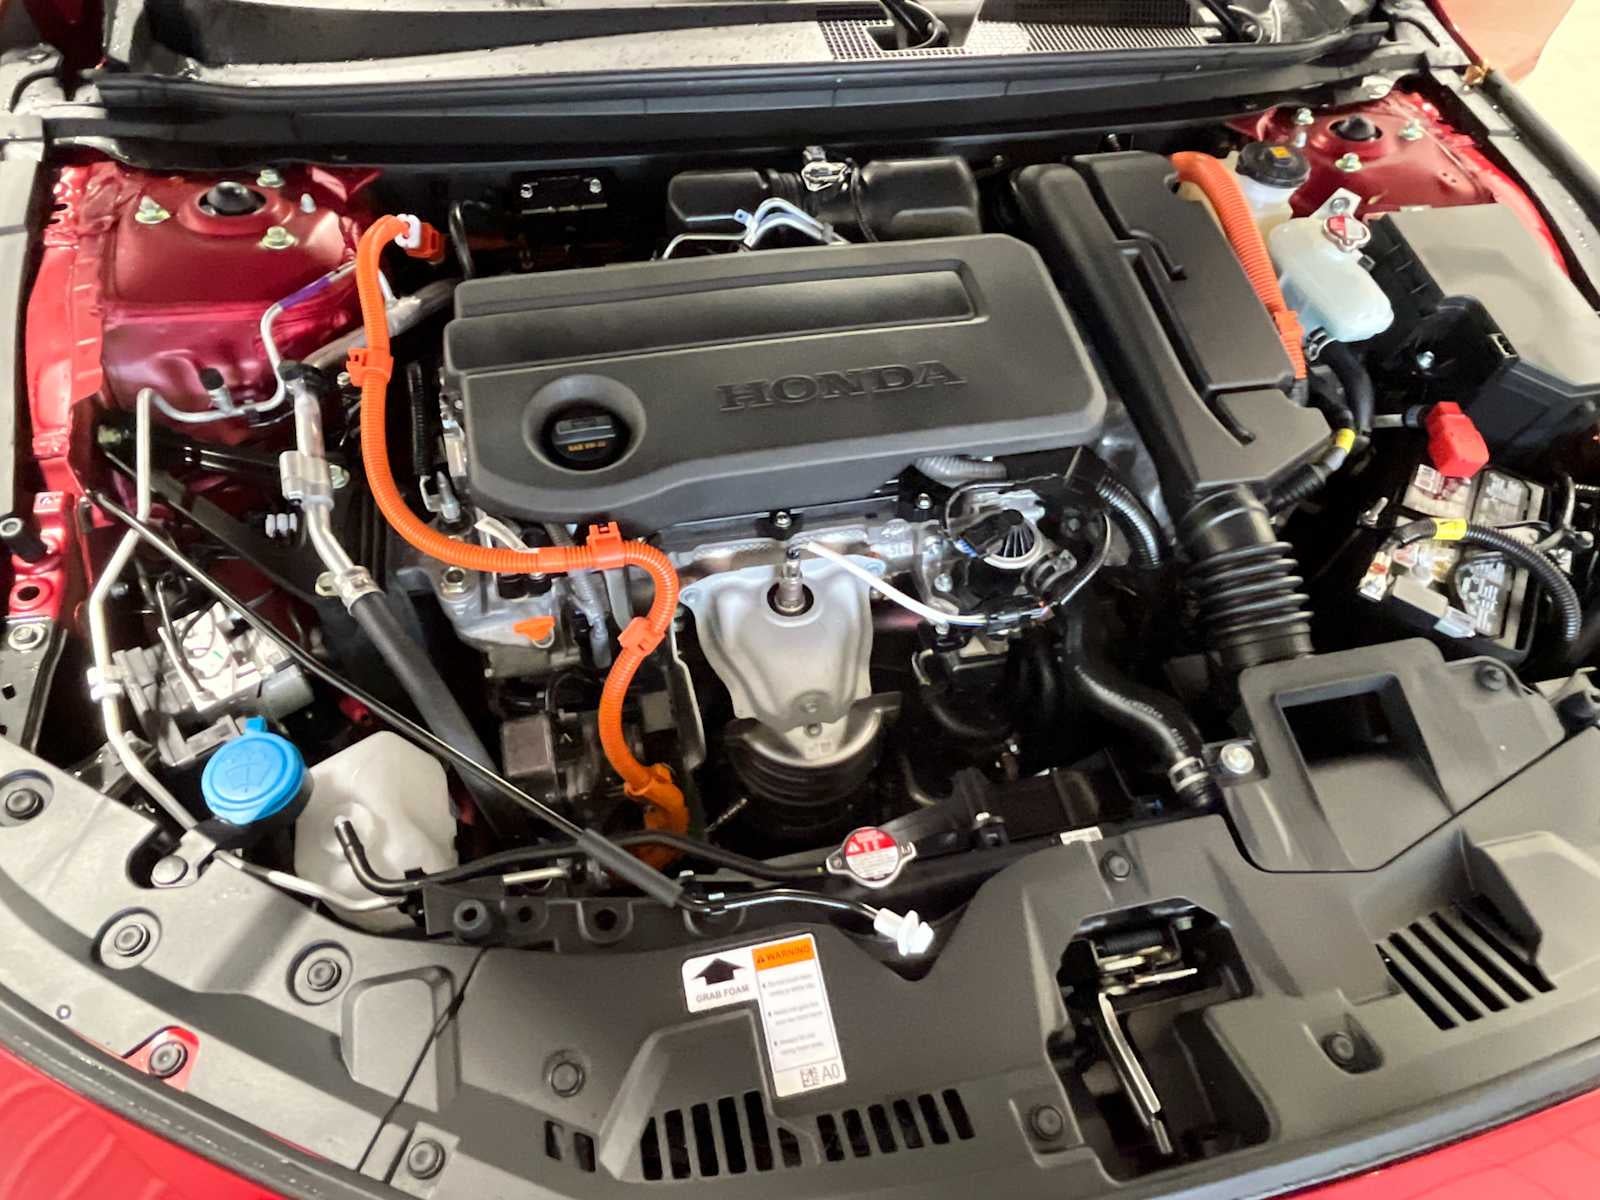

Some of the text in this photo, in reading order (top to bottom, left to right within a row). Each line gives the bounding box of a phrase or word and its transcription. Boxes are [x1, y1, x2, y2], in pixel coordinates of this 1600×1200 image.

[715, 359, 968, 412] HONDA
[766, 945, 811, 961] WARNING
[723, 984, 750, 998] FOAM
